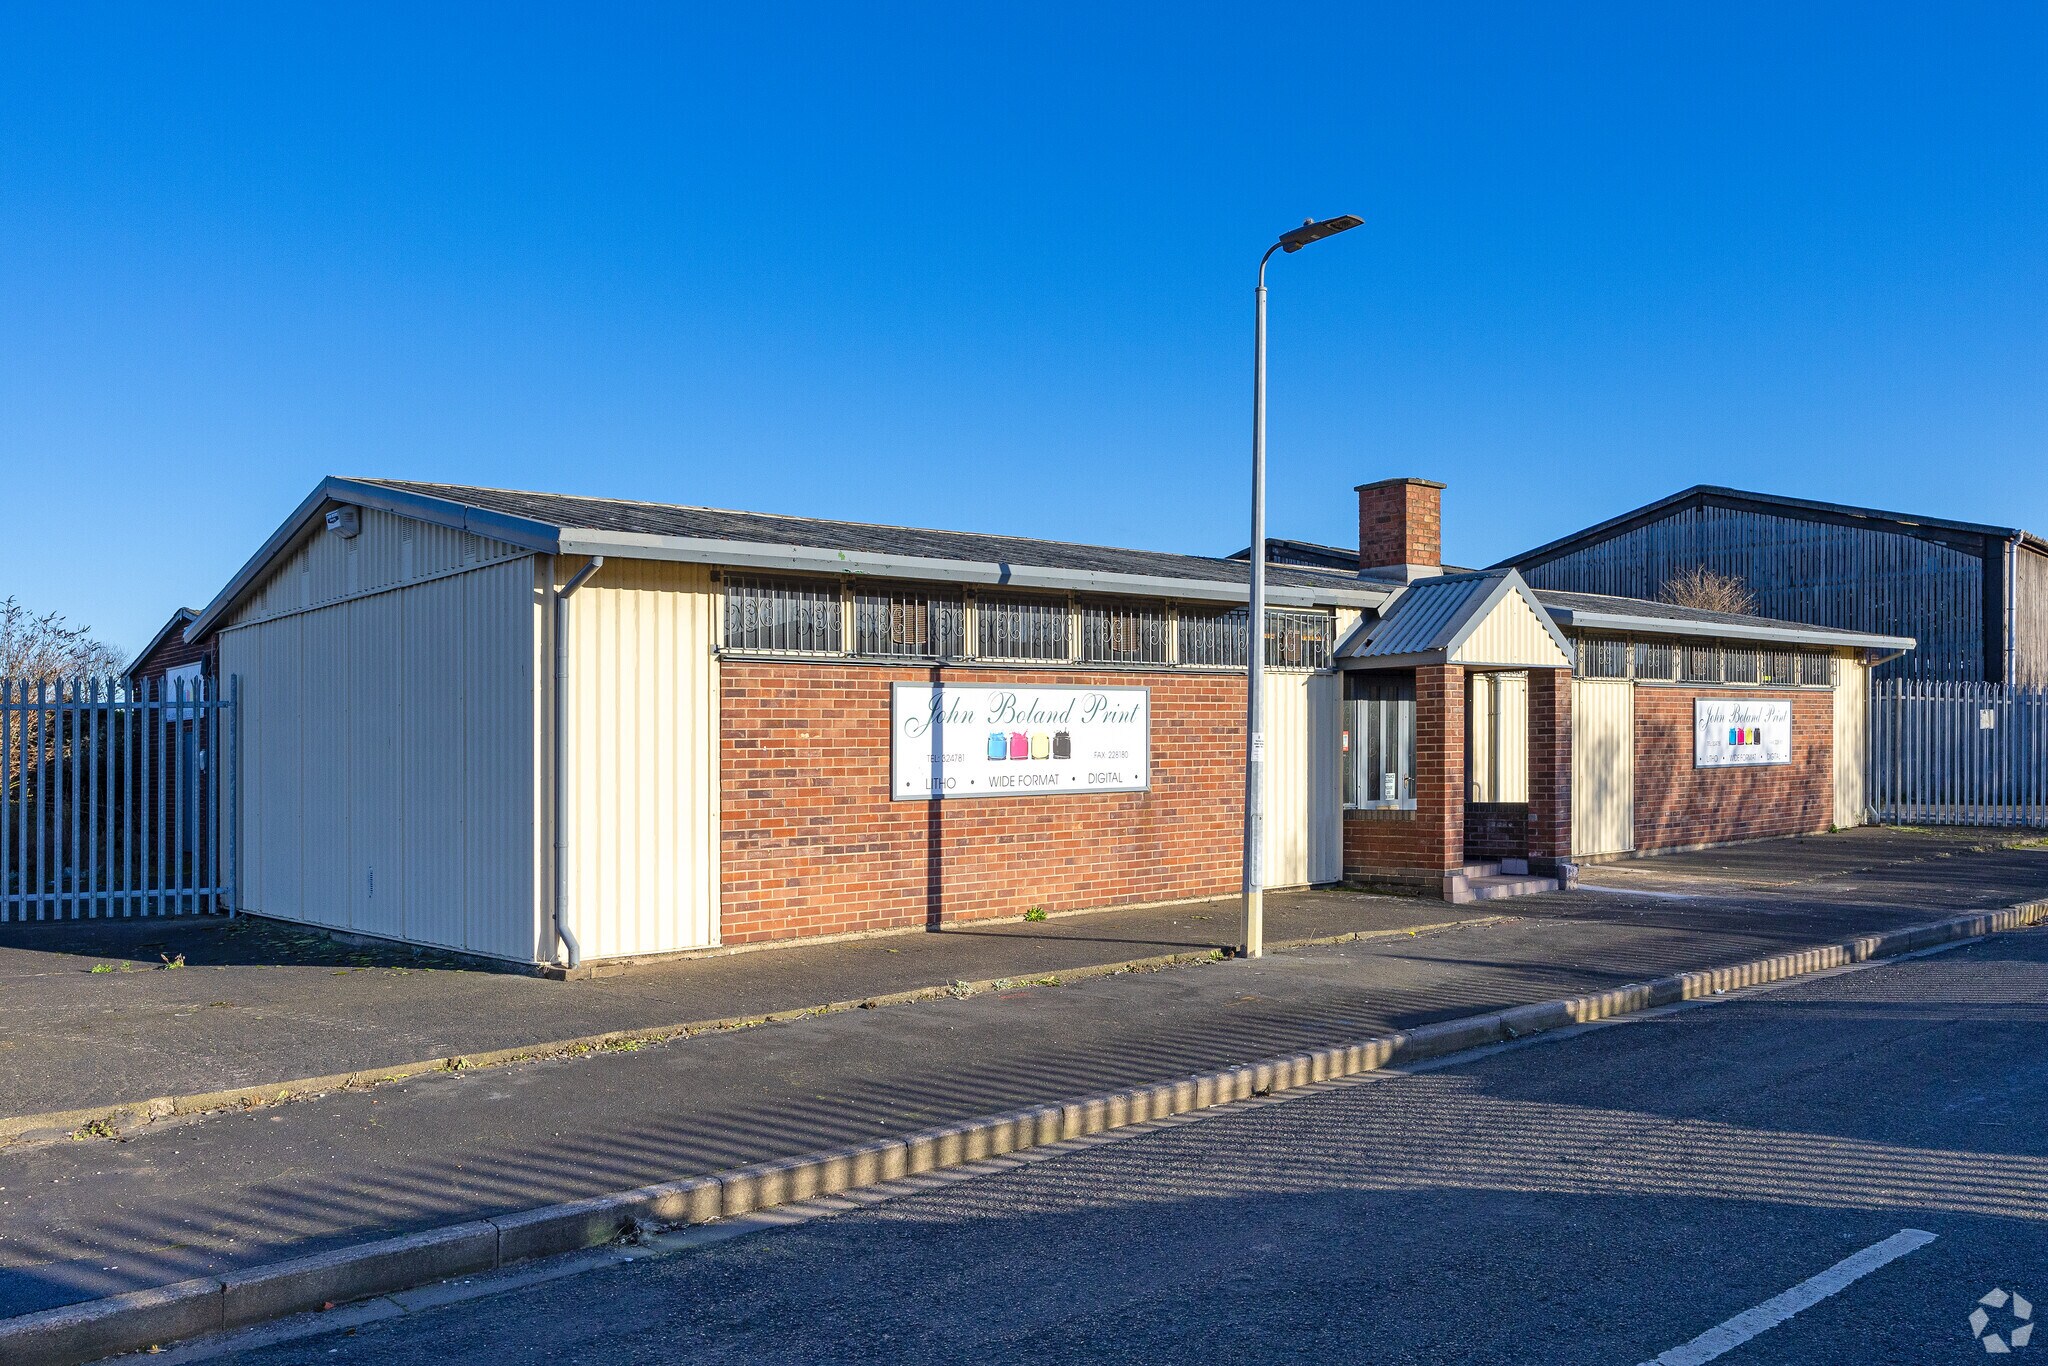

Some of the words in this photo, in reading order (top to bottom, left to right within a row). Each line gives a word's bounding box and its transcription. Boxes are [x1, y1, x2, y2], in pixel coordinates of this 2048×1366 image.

[904, 692, 976, 738] John
[987, 691, 1075, 724] Boland
[1081, 692, 1140, 725] Print
[1699, 704, 1725, 731] John
[1729, 703, 1762, 723] Boland
[1764, 704, 1787, 723] Print
[925, 777, 956, 790] LITHO
[989, 775, 1015, 788] WIDE
[1018, 773, 1059, 787] FORMAT
[1088, 772, 1123, 784] DIGITAL
